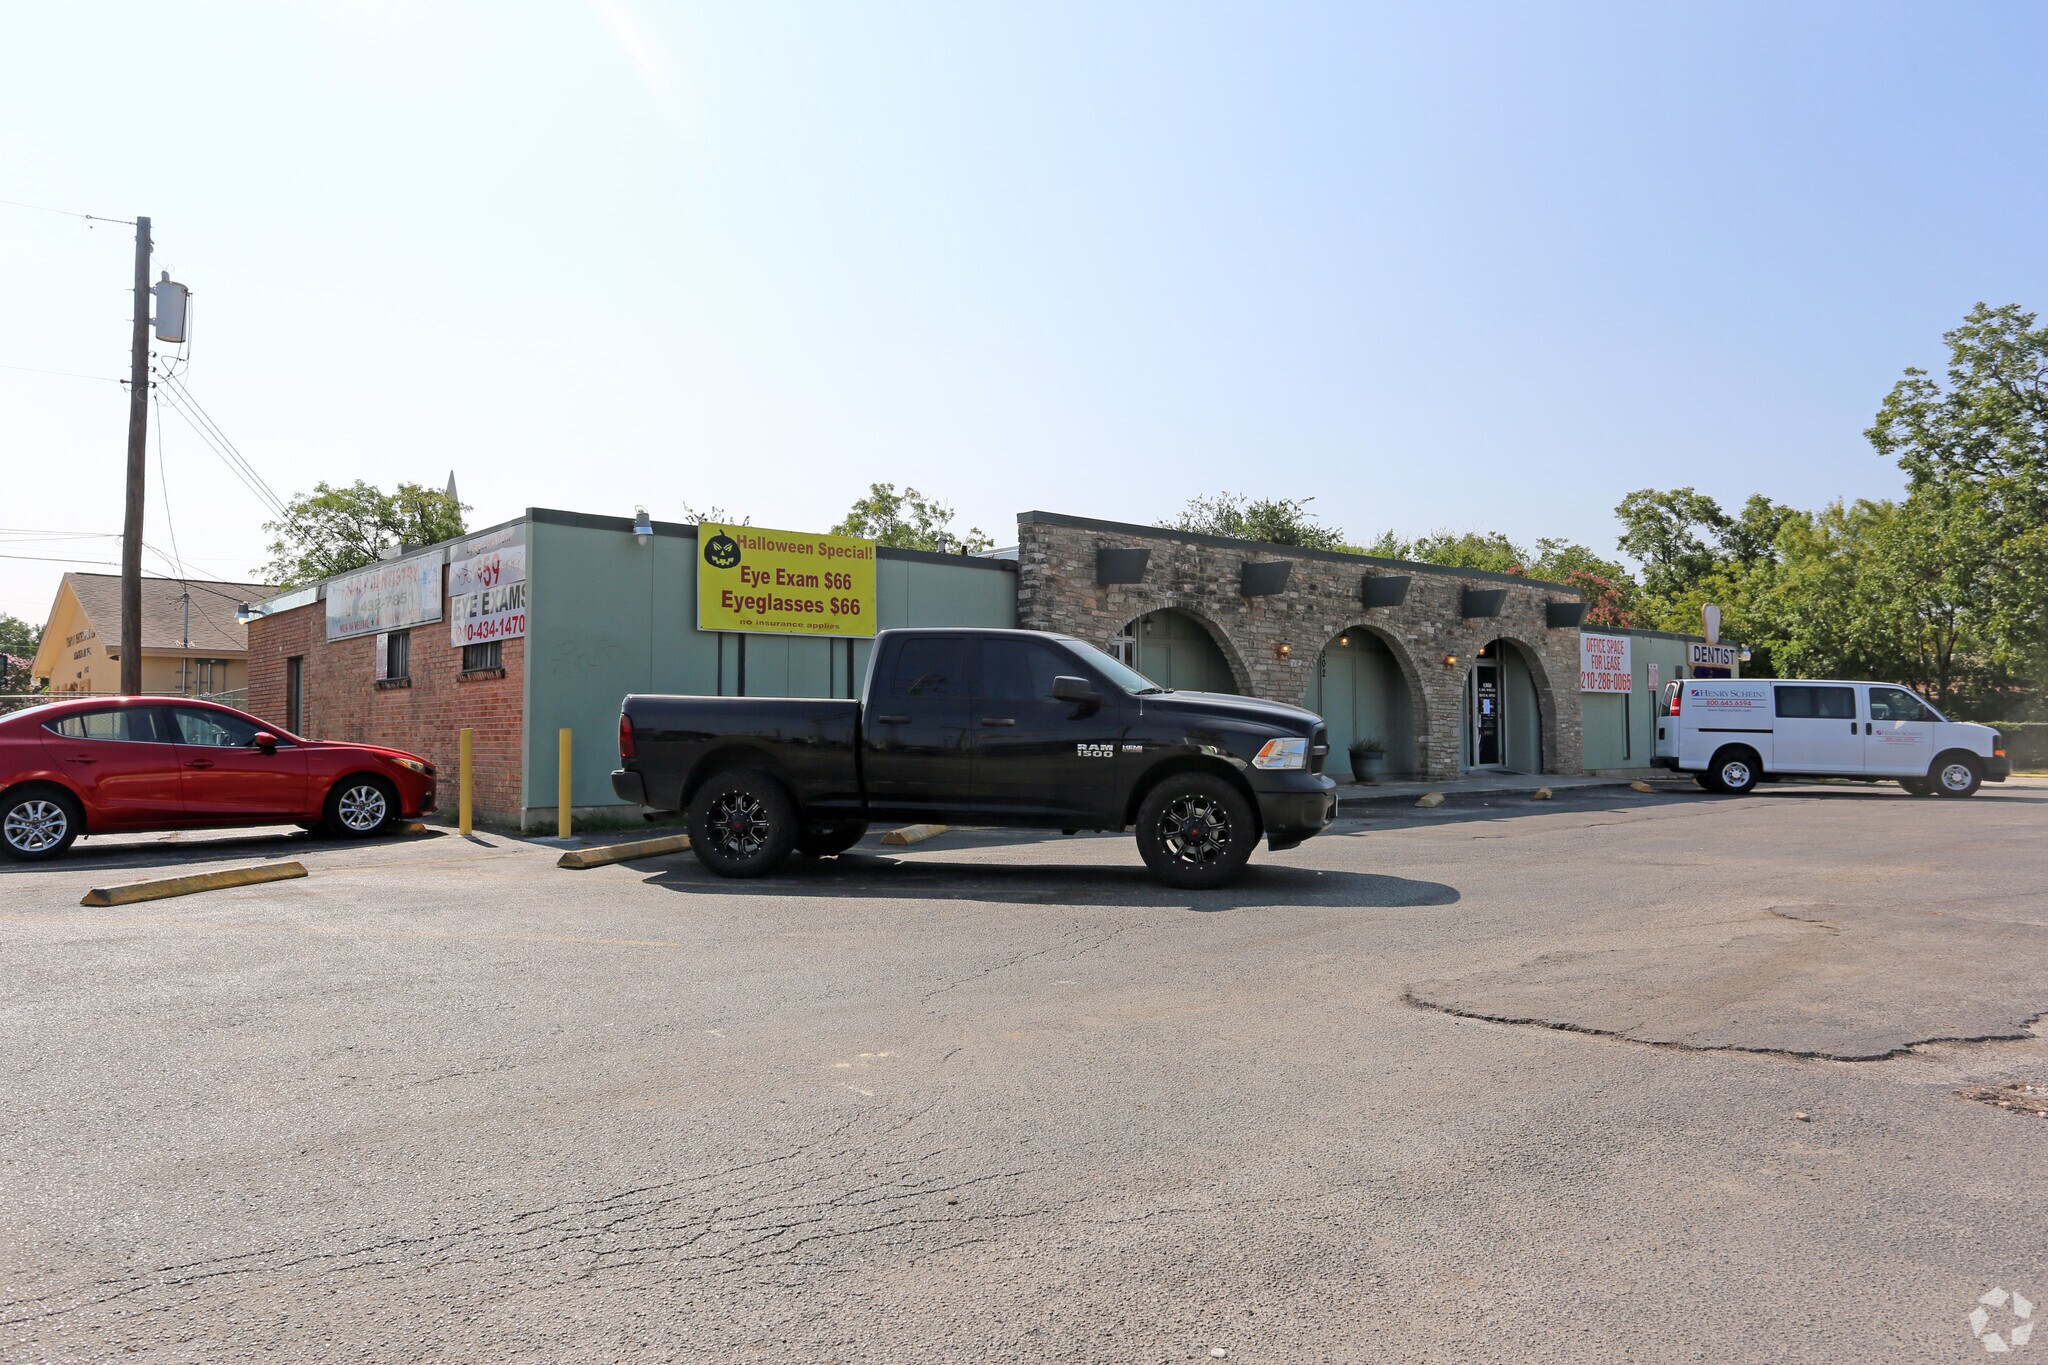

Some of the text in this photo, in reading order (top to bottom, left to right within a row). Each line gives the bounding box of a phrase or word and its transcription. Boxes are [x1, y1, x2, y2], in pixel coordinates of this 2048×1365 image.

[736, 534, 873, 560] Halloween Special!
[477, 552, 500, 587] $59
[740, 565, 852, 591] Eye Exam $66
[453, 594, 478, 622] EYE
[721, 589, 861, 616] Eyeglasses $66
[755, 619, 804, 628] insurance
[806, 621, 840, 630] applies
[1586, 637, 1625, 655] OFFICE SPACE
[1693, 645, 1735, 665] DENTIST
[1591, 654, 1621, 671] FOR LEASE
[1581, 671, 1632, 691] 210-286-0065
[1077, 743, 1114, 751] RAM
[1077, 750, 1114, 758] 1500
